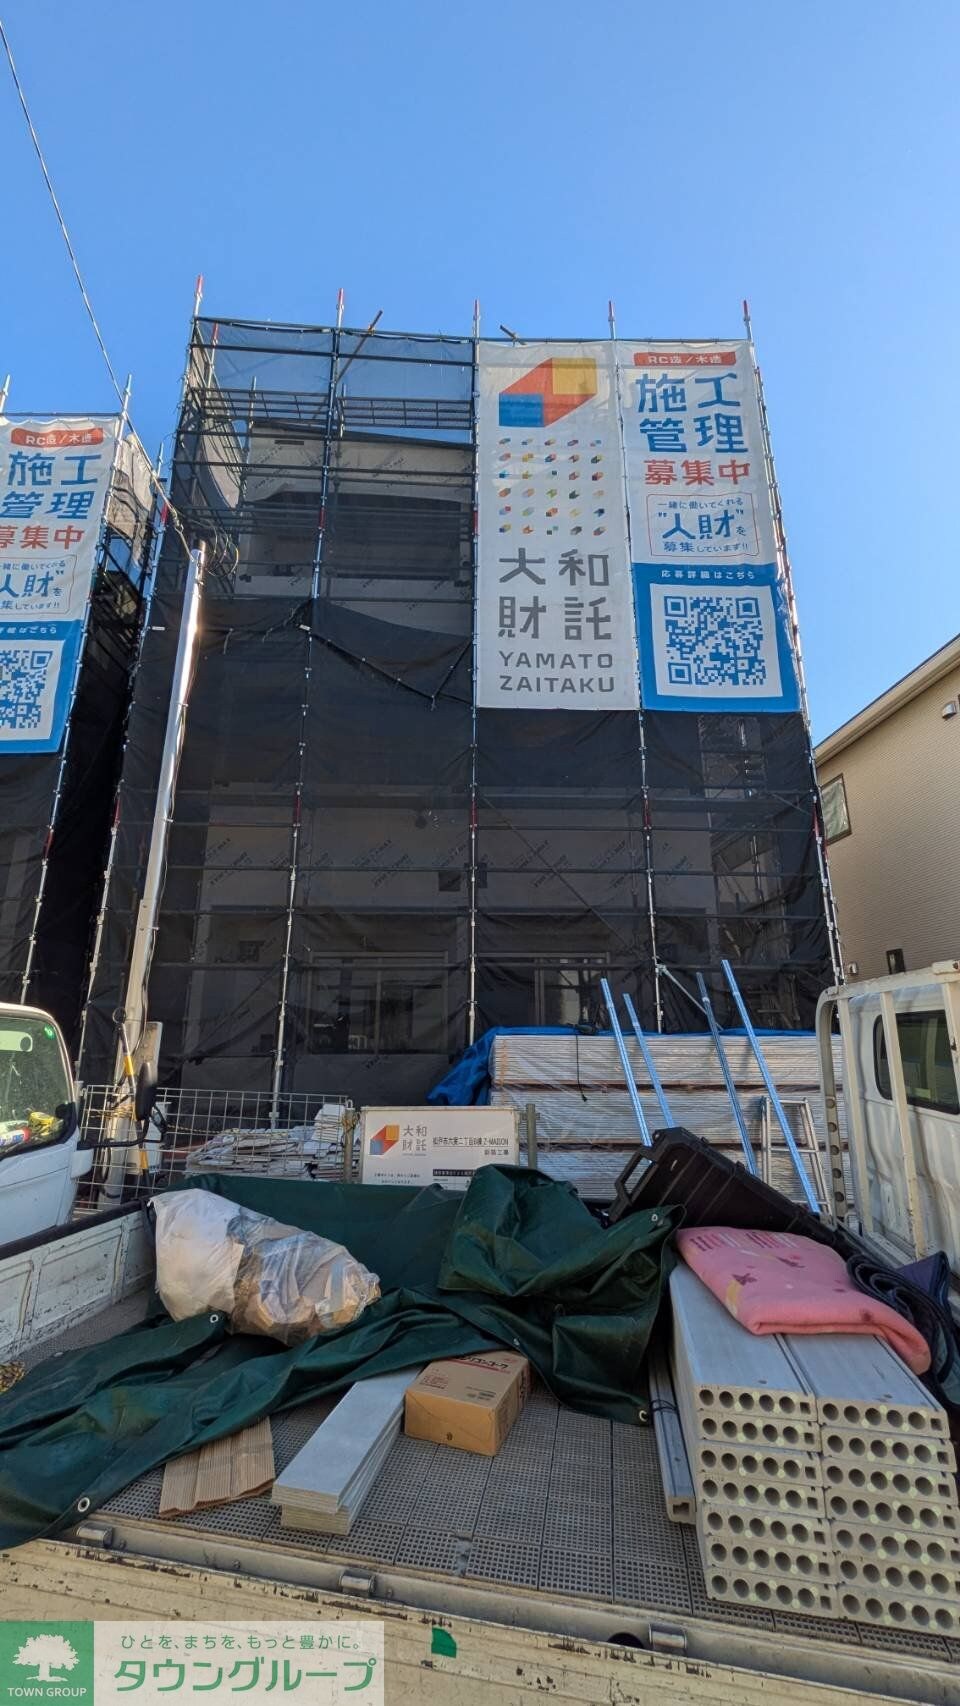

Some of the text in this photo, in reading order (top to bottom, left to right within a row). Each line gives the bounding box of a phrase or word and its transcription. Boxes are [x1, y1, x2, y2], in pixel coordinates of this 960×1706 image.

[635, 372, 741, 413] 施工
[639, 413, 749, 453] 管理
[7, 451, 101, 486] 施工
[644, 459, 751, 486] 募集中
[0, 490, 96, 520] 管理
[657, 497, 744, 510] 一緒に働いてくれる
[498, 547, 610, 587] 大和
[498, 595, 612, 641] 財託
[498, 651, 614, 670] YAMATO
[499, 675, 616, 693] ZAITAKU
[403, 1125, 428, 1137] 大和
[402, 1139, 427, 1152] 財託
